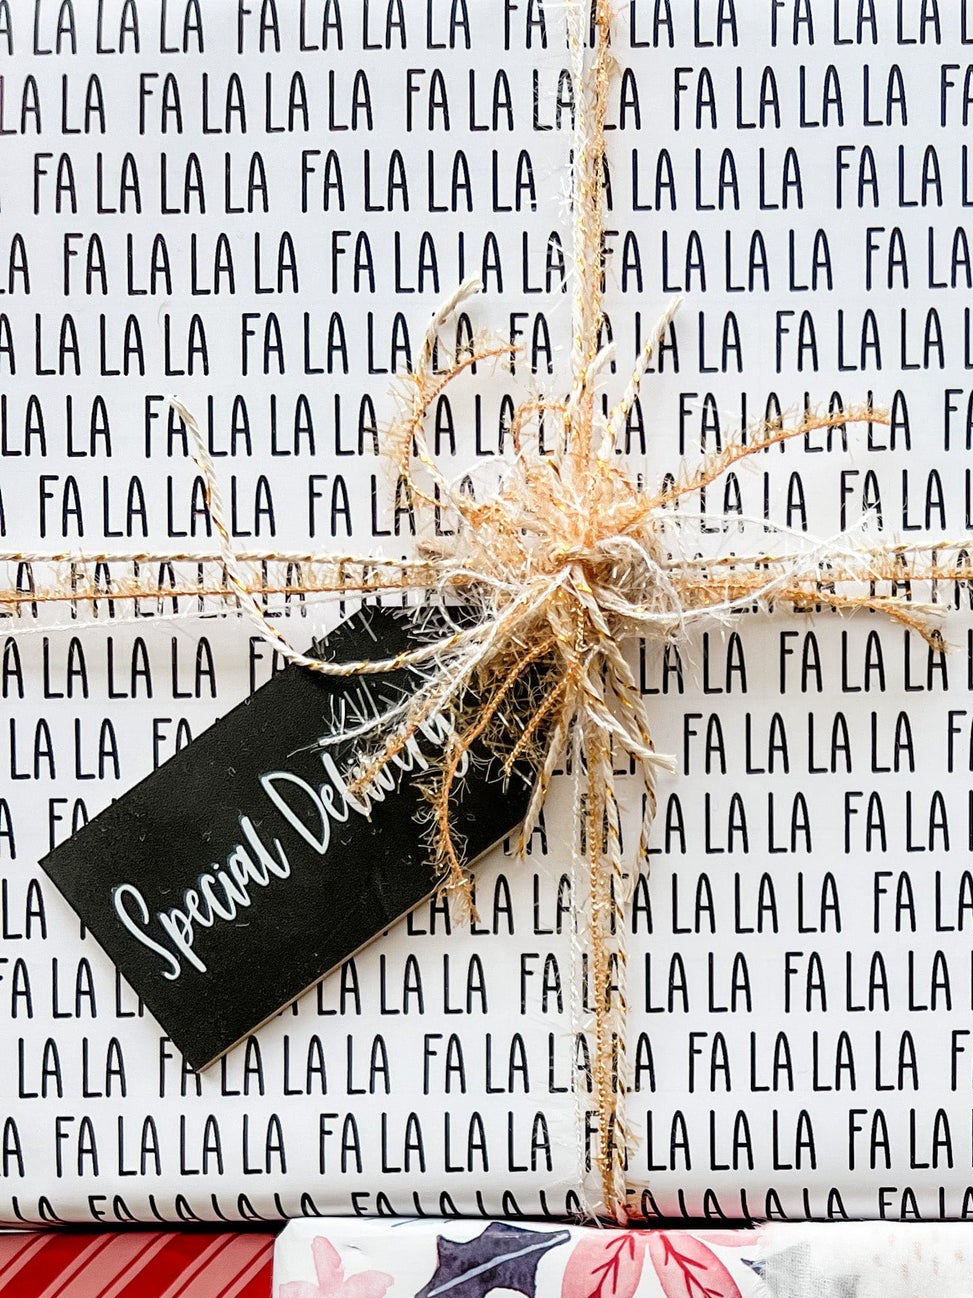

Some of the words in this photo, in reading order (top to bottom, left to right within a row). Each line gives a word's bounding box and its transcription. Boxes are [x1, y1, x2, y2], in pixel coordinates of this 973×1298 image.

[0, 75, 41, 135] LA
[62, 74, 105, 134] LA
[140, 73, 182, 135] FA
[203, 73, 246, 134] LA
[266, 71, 309, 133] LA
[329, 69, 373, 131] LA
[407, 69, 450, 132] FA
[469, 69, 513, 131] LA
[675, 67, 717, 131] FA
[737, 66, 780, 129] LA
[800, 65, 843, 128] LA
[864, 64, 907, 126] LA
[36, 313, 80, 375] LA
[100, 314, 145, 376] LA
[165, 314, 209, 376] LA
[242, 312, 284, 376] FA
[304, 312, 348, 374] LA
[368, 312, 412, 374] LA
[510, 312, 552, 374] FA
[699, 311, 742, 373] LA
[776, 310, 818, 373] FA
[838, 309, 881, 371] LA
[901, 308, 944, 370] LA
[10, 718, 55, 779] LA
[75, 718, 120, 779] LA
[684, 713, 726, 775] FA
[746, 713, 789, 774] LA
[808, 712, 851, 774] LA
[871, 711, 914, 773] LA
[115, 816, 291, 981] Special
[785, 952, 826, 1013] FA
[847, 951, 889, 1011] LA
[909, 950, 951, 1011] LA
[56, 1116, 98, 1178] FA
[118, 1115, 161, 1176] LA
[180, 1115, 223, 1175] LA
[243, 1114, 286, 1174] LA
[320, 1113, 362, 1174] FA
[382, 1112, 425, 1173] LA
[445, 1112, 488, 1172] LA
[508, 1111, 552, 1172] LA
[647, 1110, 691, 1171] LA
[710, 1110, 754, 1171] LA
[773, 1110, 816, 1170] LA
[849, 1109, 891, 1171] FA
[910, 1108, 953, 1169] LA
